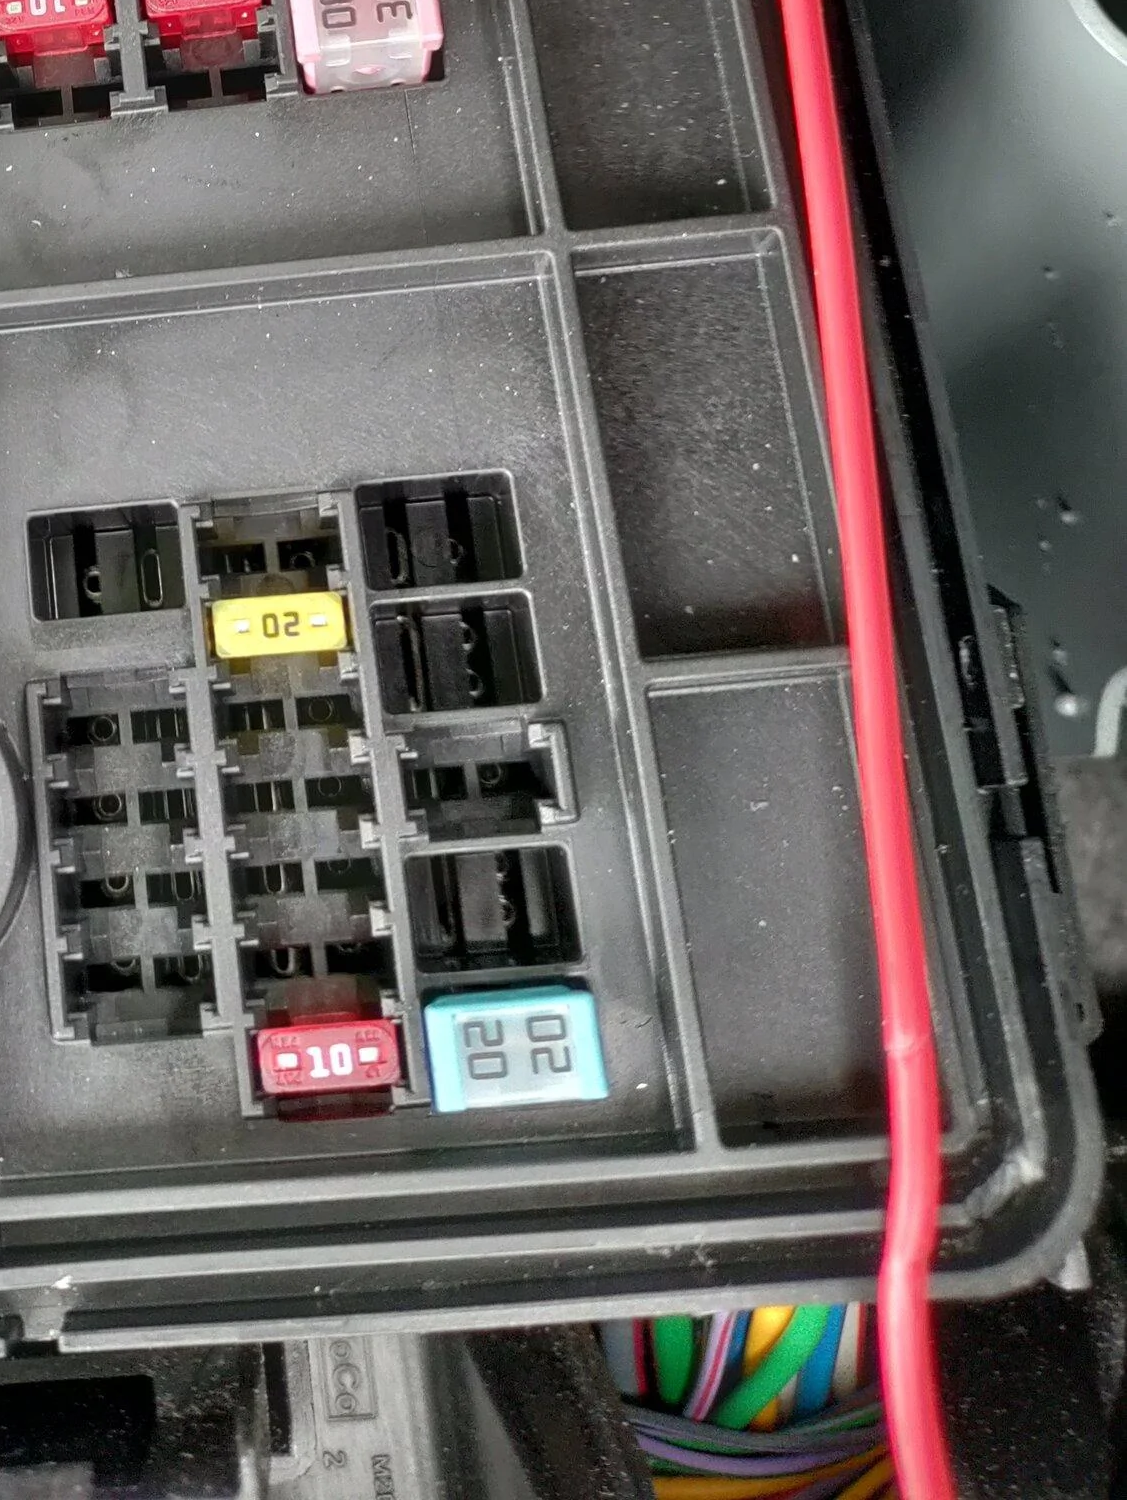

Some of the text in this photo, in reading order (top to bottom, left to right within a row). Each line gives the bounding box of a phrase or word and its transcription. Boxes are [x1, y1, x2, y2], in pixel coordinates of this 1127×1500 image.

[262, 611, 300, 638] 20
[305, 1043, 353, 1078] 10
[462, 1019, 508, 1080] 20
[526, 1014, 572, 1075] 20
